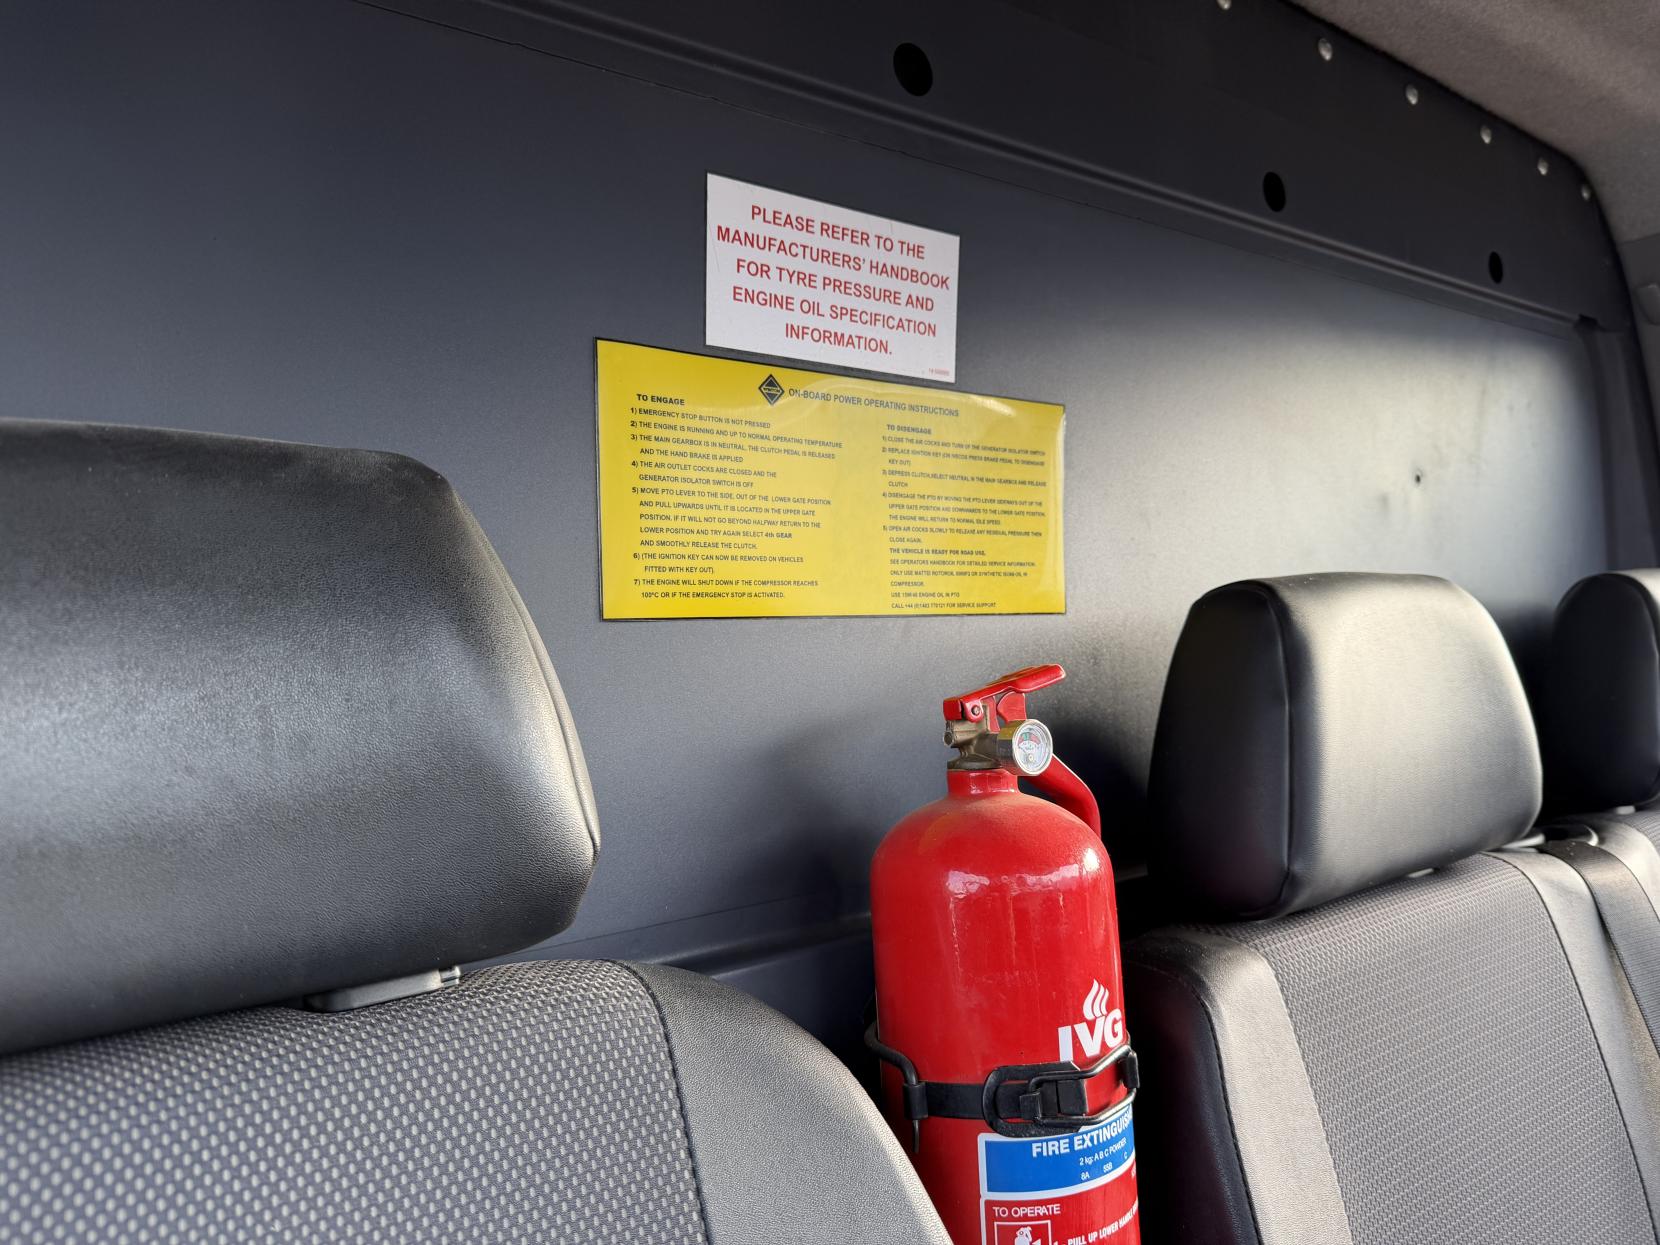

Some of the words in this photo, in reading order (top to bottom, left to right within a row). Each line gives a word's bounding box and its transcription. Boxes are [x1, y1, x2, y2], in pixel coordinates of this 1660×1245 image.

[751, 204, 815, 234] PLEASE
[820, 221, 870, 248] REFER
[874, 234, 894, 253] TO
[898, 240, 925, 260] THE
[870, 260, 950, 290] HANDBOOK
[736, 258, 771, 280] FOR
[776, 266, 817, 289] TYRE
[822, 277, 901, 306] PRESSURE
[905, 294, 934, 312] AND
[732, 286, 795, 311] ENGINE
[799, 299, 825, 318] OIL
[829, 304, 937, 338] SPECIFICATION
[785, 323, 893, 355] INFORMATION.
[636, 393, 648, 401] TO
[650, 394, 684, 405] ENGAGE
[788, 387, 831, 401] ON-BOARD
[833, 393, 862, 405] POWER
[863, 397, 906, 411] OPERATING
[907, 403, 958, 417] INSTRUCTIONS
[638, 407, 679, 418] EMERGENCY
[680, 412, 697, 420] STOP
[638, 420, 652, 429] THE
[653, 422, 677, 431] ENGINE
[686, 426, 714, 435] RUNNING
[715, 428, 728, 436] AND
[639, 433, 652, 442] THE
[653, 435, 670, 443] MAIN
[671, 437, 702, 446] GEARBOX
[655, 448, 668, 456] THE
[688, 451, 710, 459] BRAKE
[639, 460, 652, 468] THE
[666, 462, 691, 470] OUTLET
[692, 464, 714, 472] COCKS
[714, 466, 727, 474] ARE
[638, 473, 679, 482] GENERATOR
[680, 476, 710, 485] ISOLATOR
[711, 478, 734, 486] SWITCH
[639, 486, 659, 494] MOVE
[675, 488, 696, 496] LEVER
[654, 500, 671, 508] PULL
[672, 501, 704, 509] UPWARDS
[655, 539, 690, 547] SMOOTHLY
[1058, 1008, 1124, 1061] IVG
[1032, 1139, 1070, 1158] FIRE
[1080, 1157, 1084, 1166] 2
[1094, 1153, 1099, 1161] A
[1104, 1149, 1109, 1157] C
[993, 1207, 1008, 1217] TO
[1012, 1204, 1061, 1218] OPERATE
[1088, 1231, 1098, 1243] UP
[1099, 1221, 1119, 1239] LOWER
